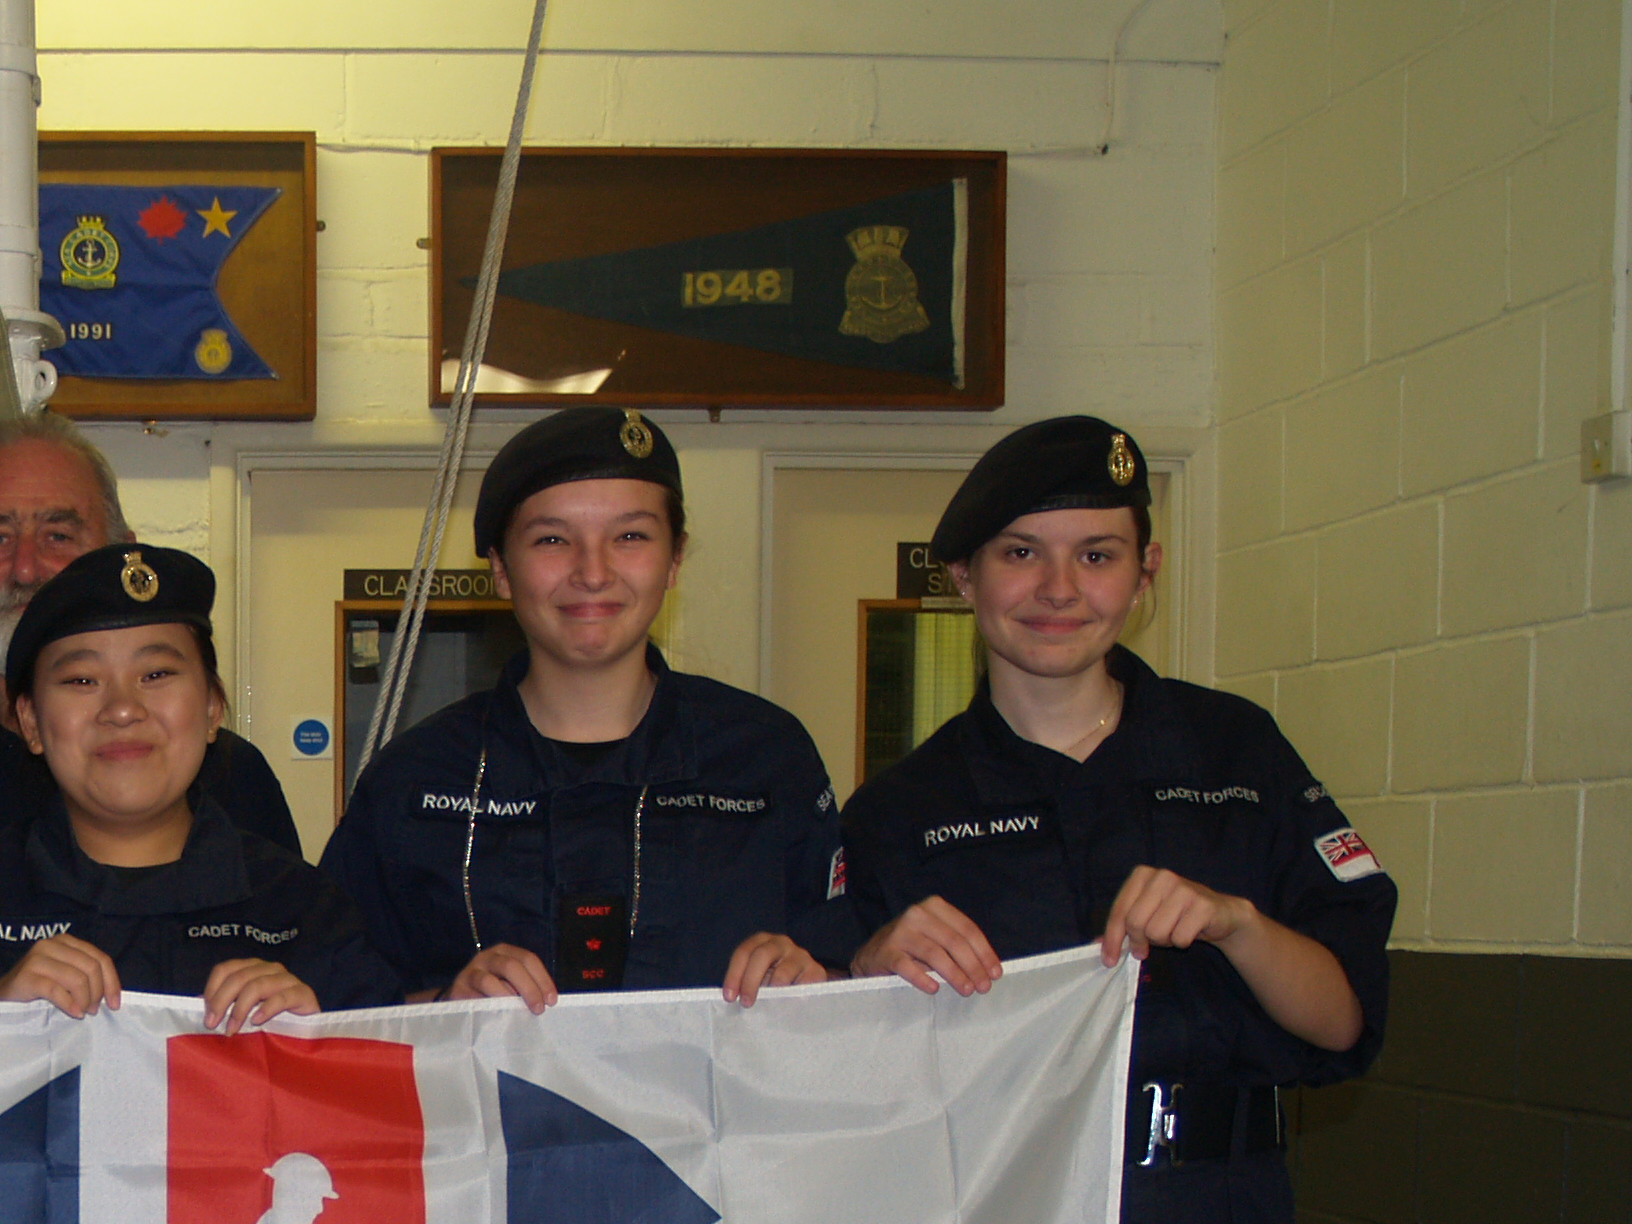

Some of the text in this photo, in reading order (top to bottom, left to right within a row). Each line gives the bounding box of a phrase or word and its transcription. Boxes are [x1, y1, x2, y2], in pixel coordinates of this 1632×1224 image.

[684, 268, 782, 306] 1948
[70, 323, 113, 340] 1991
[364, 574, 494, 597] CLASROO
[422, 793, 537, 817] ROYAL NAVY
[656, 794, 766, 813] CADET FORCES
[1155, 786, 1260, 804] CADET FORCES
[924, 815, 1039, 848] ROYAL NAVY
[576, 905, 612, 917] CADET
[19, 921, 73, 942] NAVY
[188, 923, 300, 945] CADET FORCES
